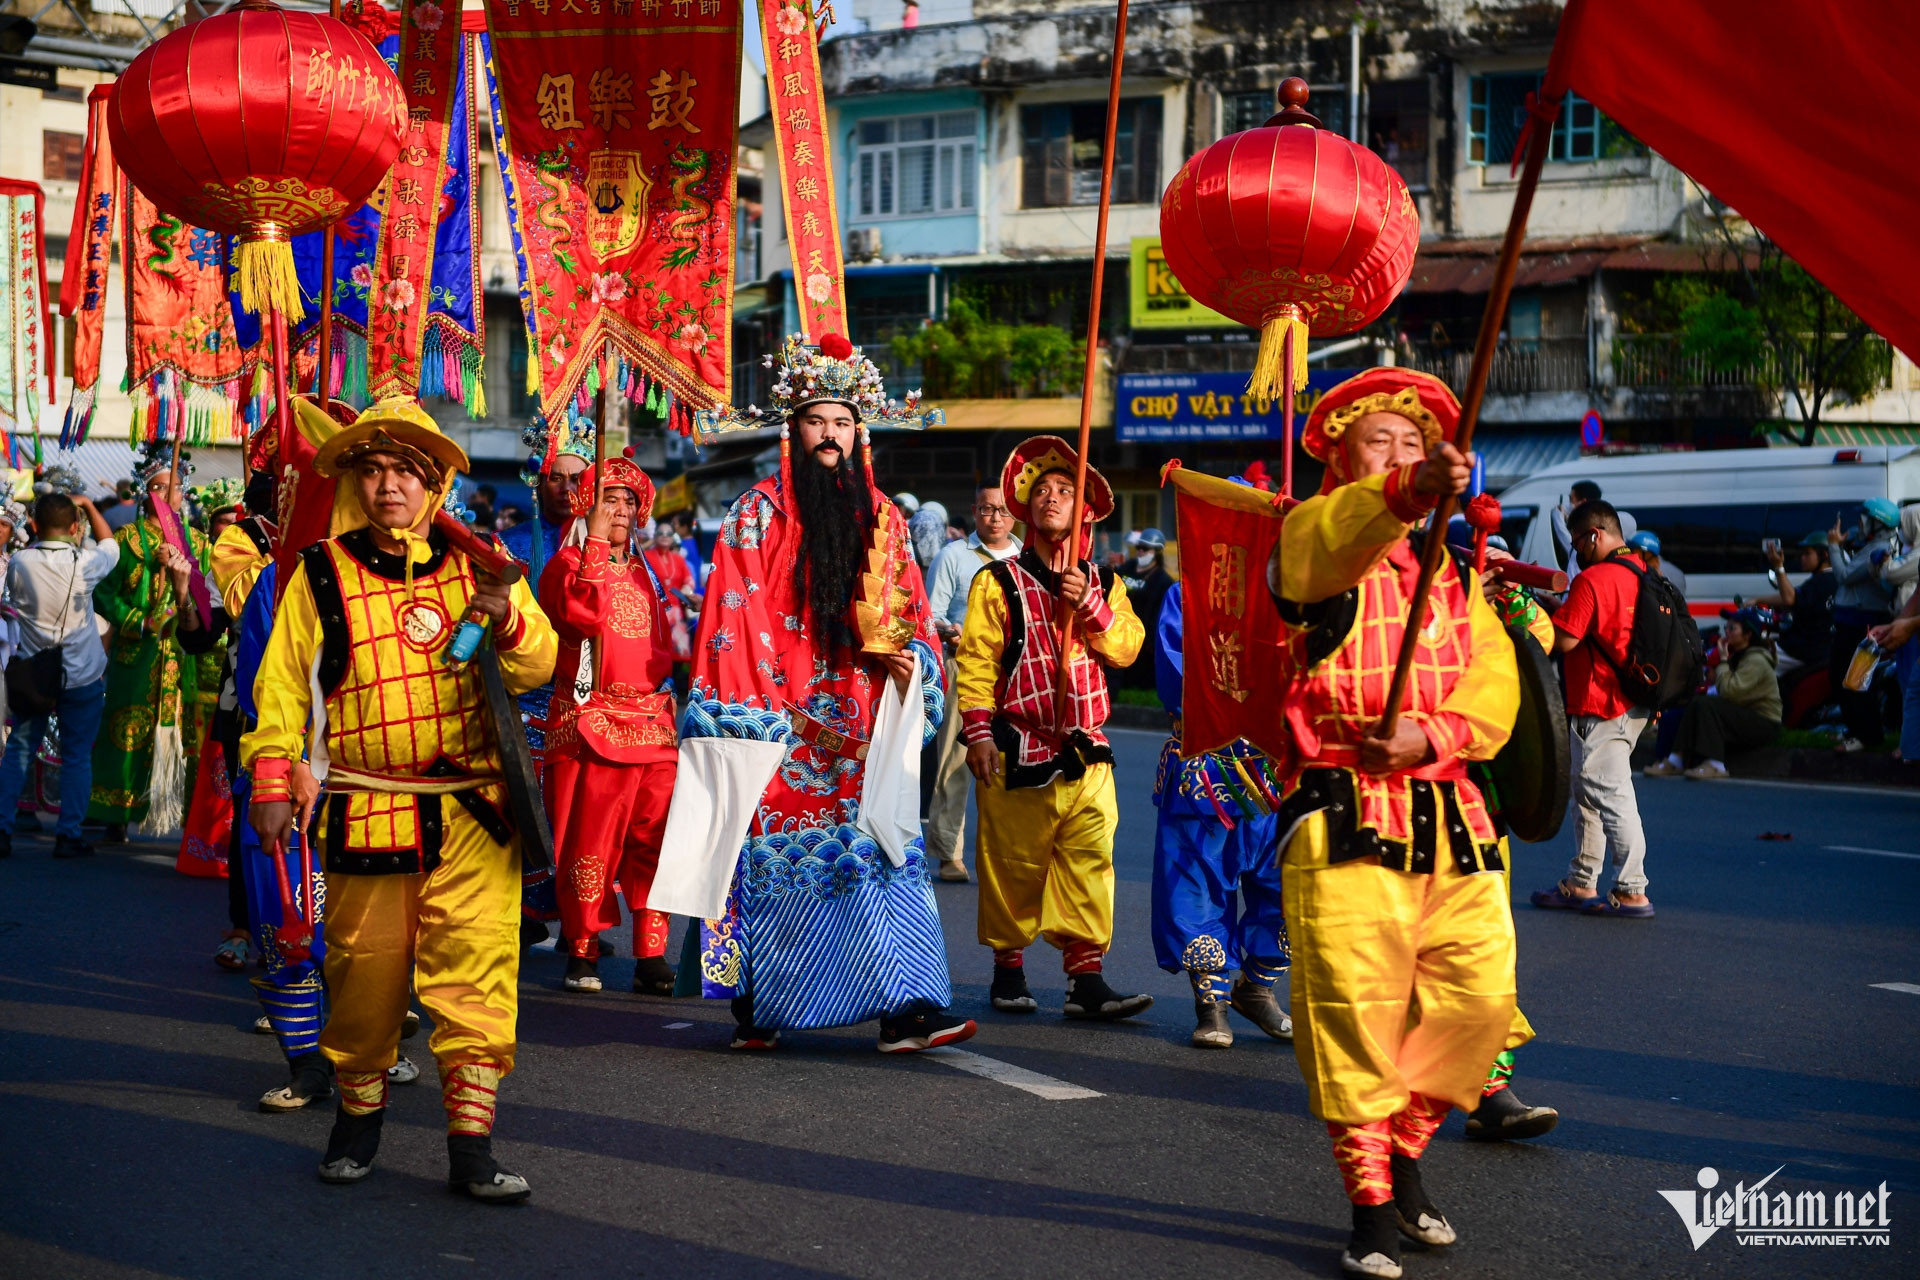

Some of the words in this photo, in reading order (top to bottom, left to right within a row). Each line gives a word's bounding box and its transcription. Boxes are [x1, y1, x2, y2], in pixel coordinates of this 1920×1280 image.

[392, 32, 436, 279] 義氣齊心歌舜日
[777, 38, 829, 274] 和風協奏樂堯天
[1131, 393, 1179, 420] CHỢ
[1188, 390, 1234, 420] VẬT
